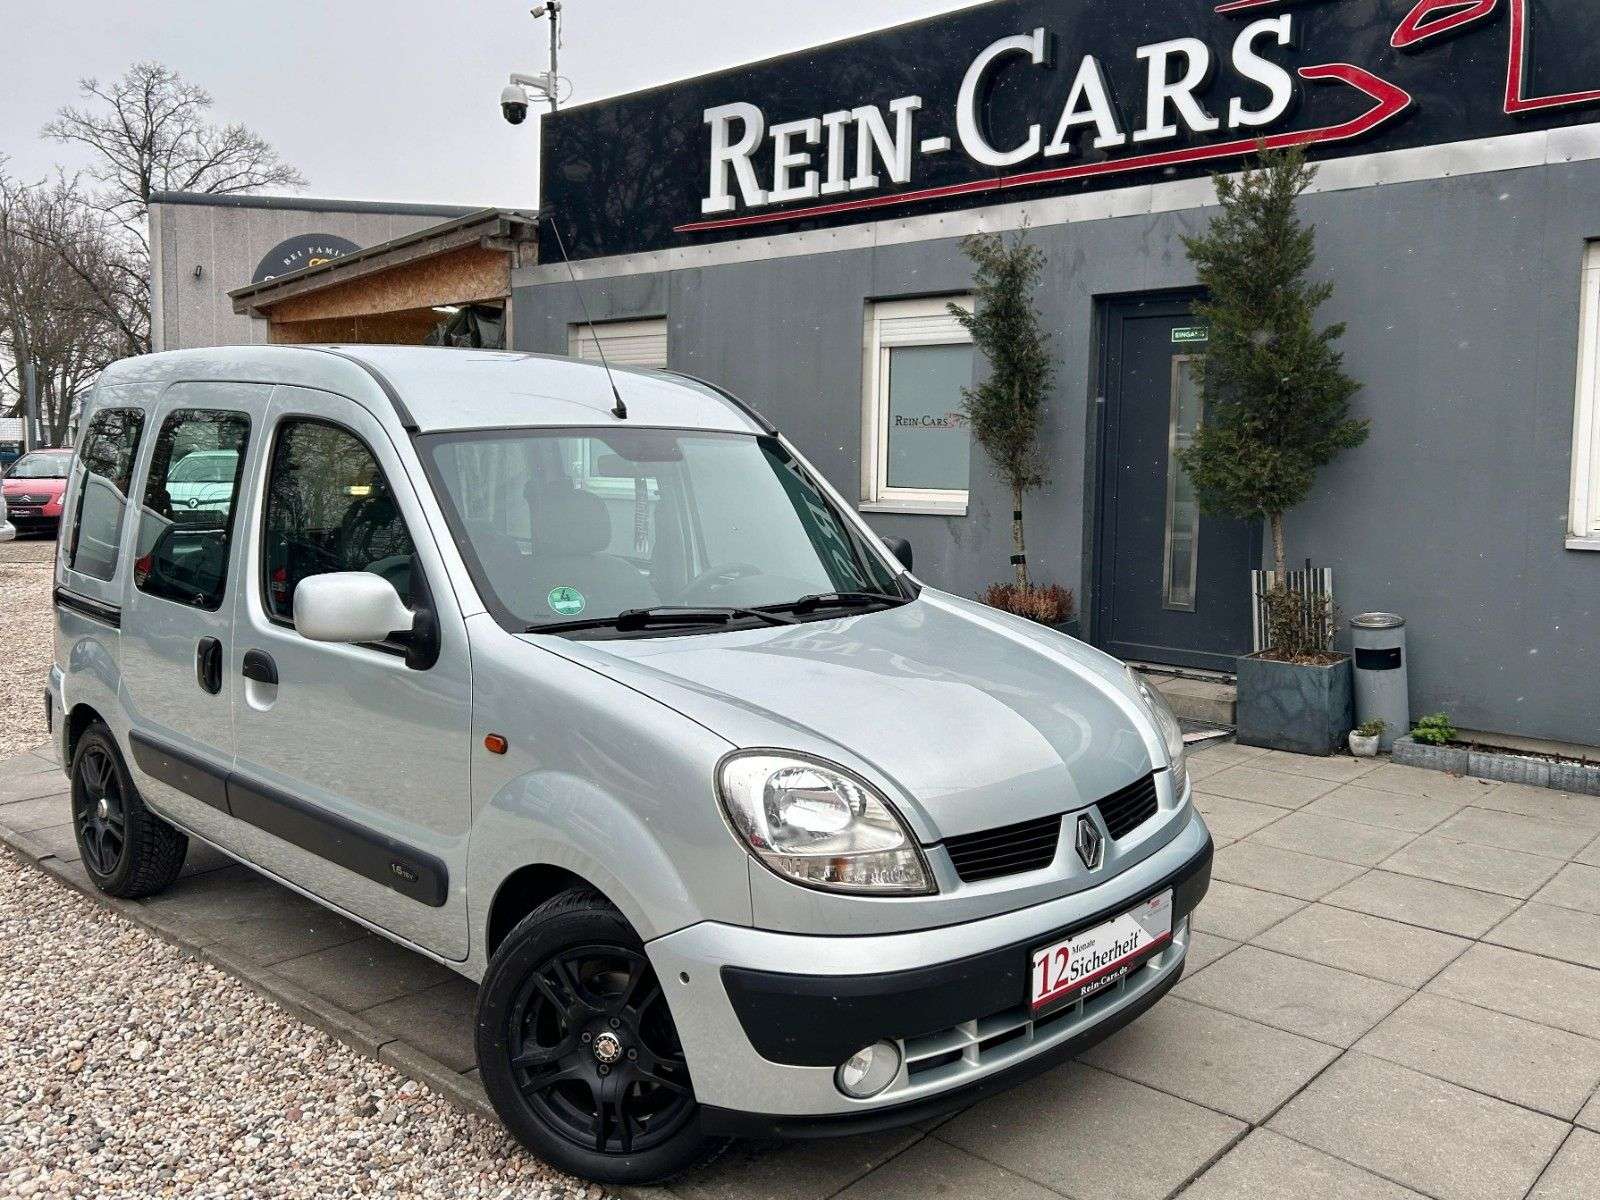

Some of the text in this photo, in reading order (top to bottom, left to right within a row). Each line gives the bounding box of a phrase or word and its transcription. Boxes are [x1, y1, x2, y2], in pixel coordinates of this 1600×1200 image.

[283, 250, 302, 266] BEI
[1072, 939, 1096, 954] Monate
[1037, 946, 1070, 998] 12
[1080, 965, 1129, 996] Rein-Cars.de
